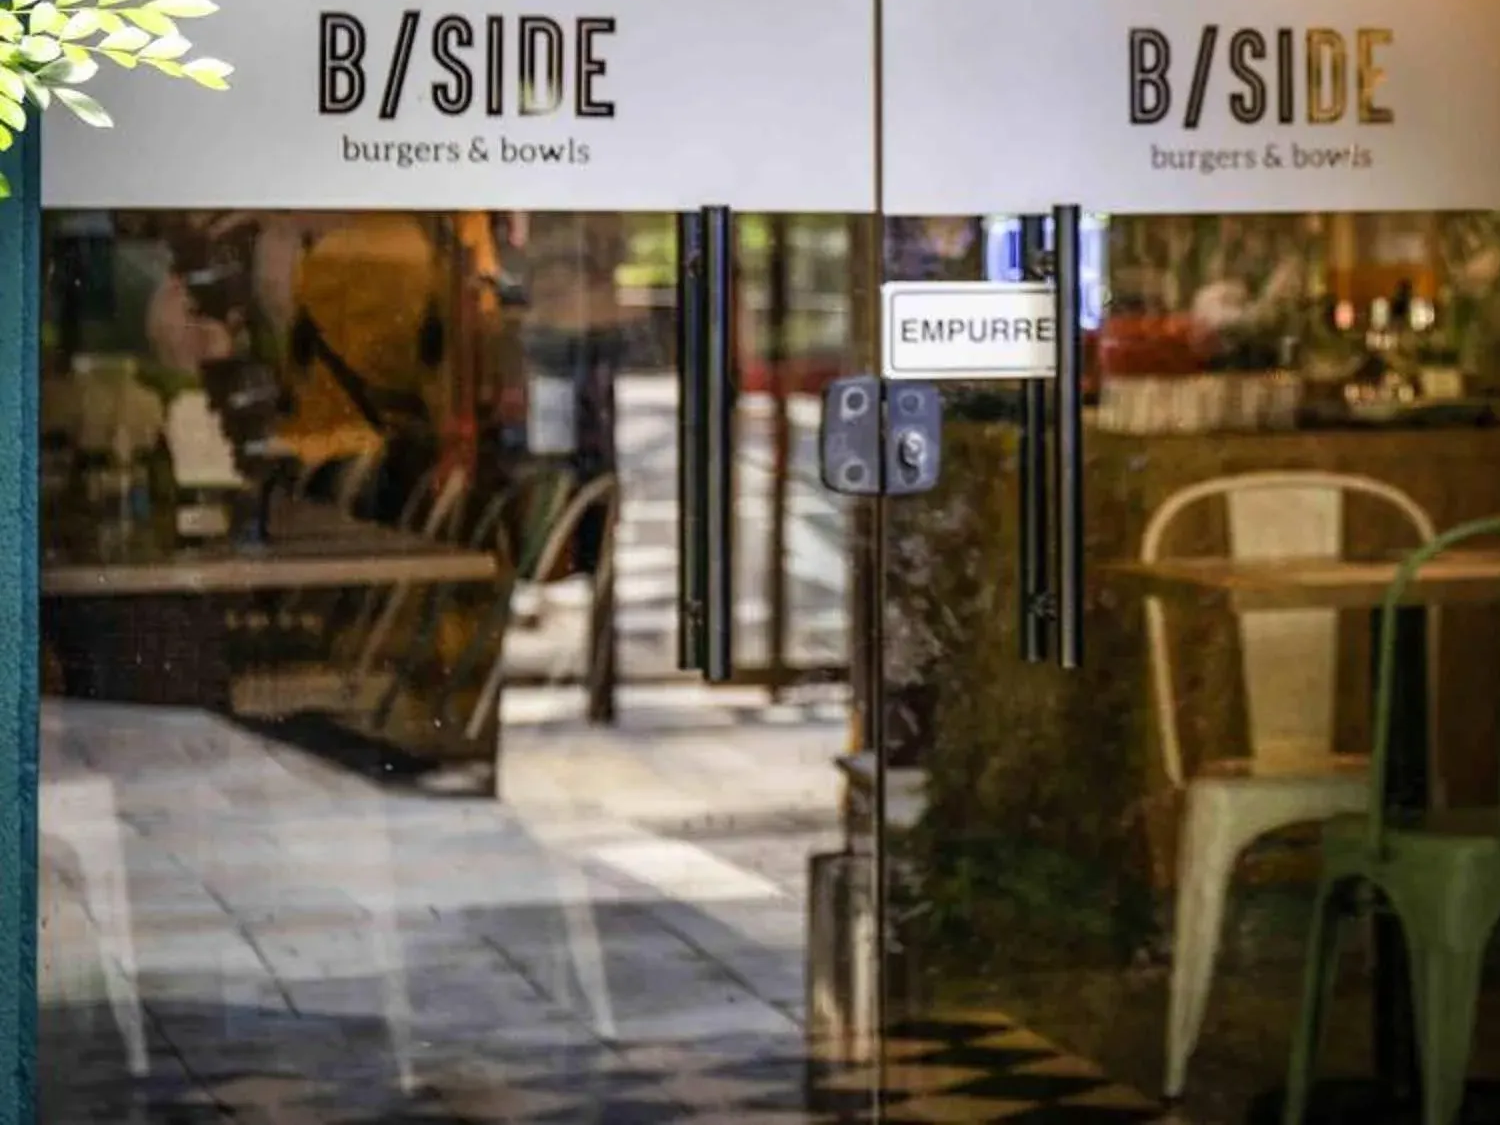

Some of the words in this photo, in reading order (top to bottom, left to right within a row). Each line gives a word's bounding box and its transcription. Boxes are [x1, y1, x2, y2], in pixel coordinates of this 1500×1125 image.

[319, 10, 616, 119] B/SIDE
[1128, 24, 1396, 130] B/SIDE
[342, 134, 461, 167] burgers
[467, 136, 489, 163] &
[500, 135, 591, 164] bowls
[1151, 143, 1257, 174] burgers
[1262, 143, 1284, 169] &
[1291, 142, 1373, 169] bowls
[900, 317, 1056, 344] EMPURRE
